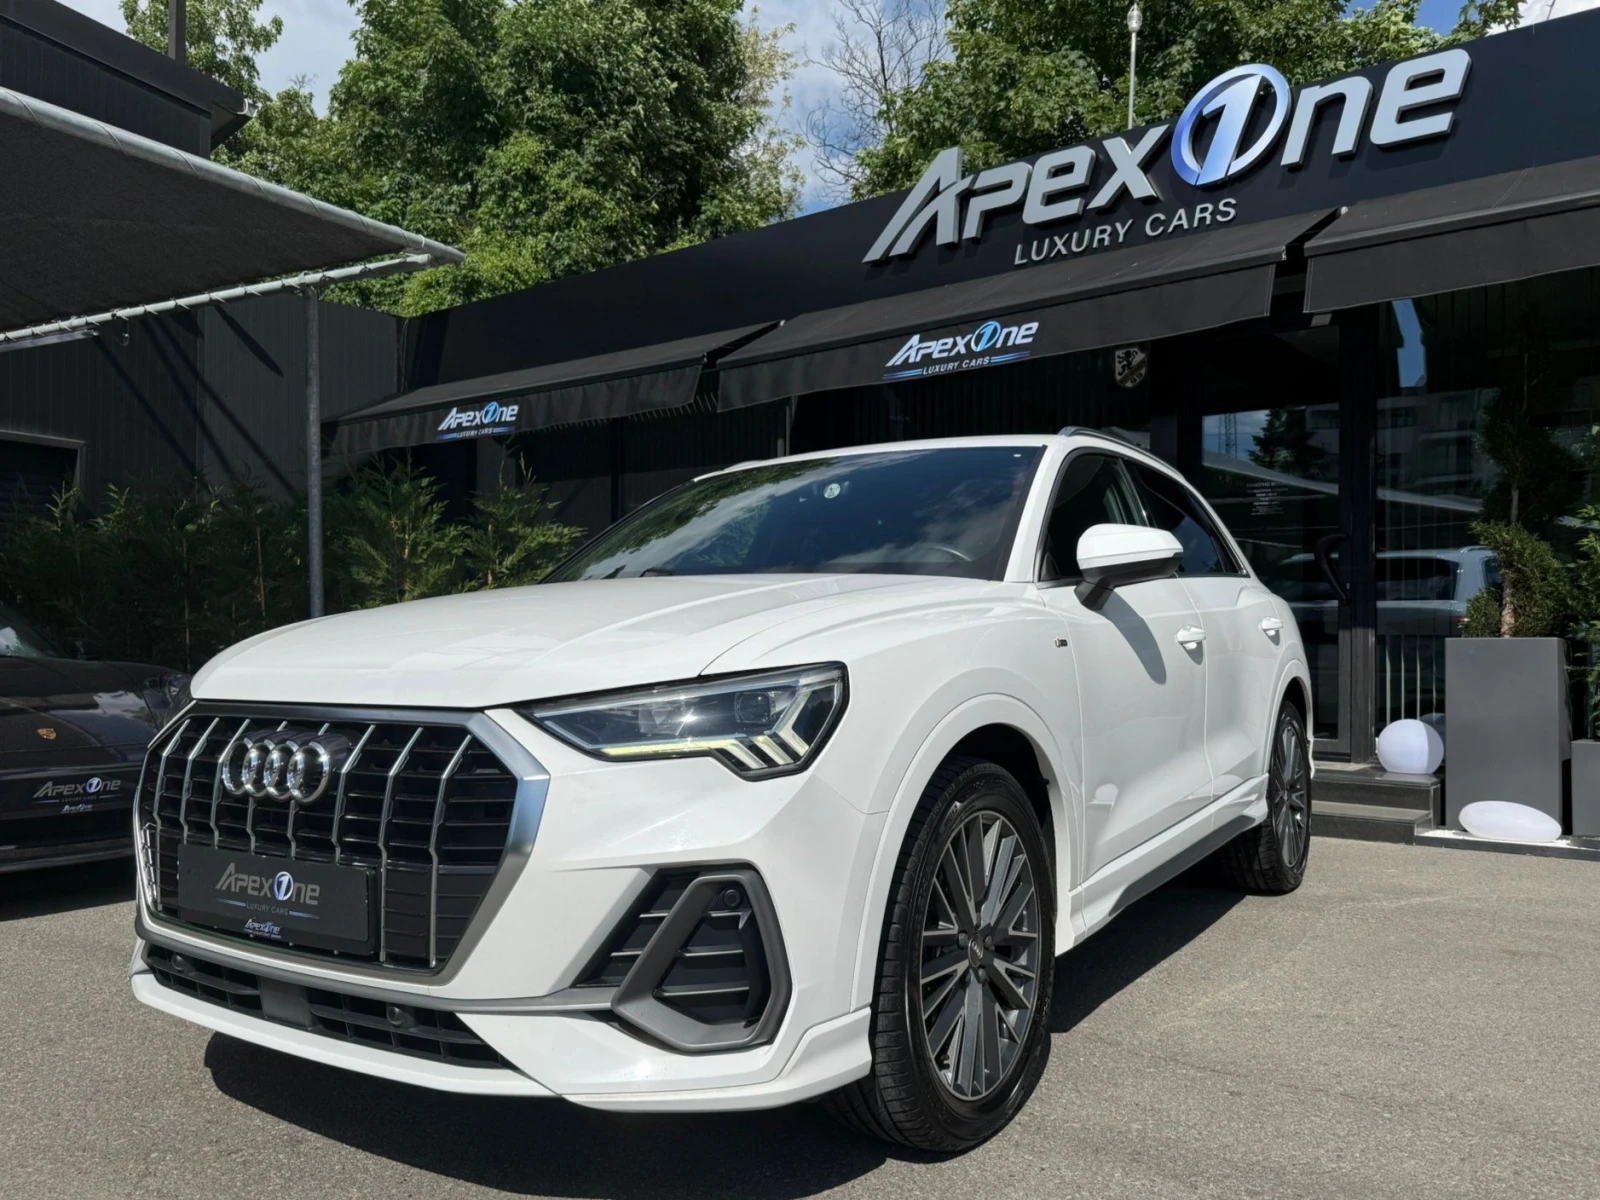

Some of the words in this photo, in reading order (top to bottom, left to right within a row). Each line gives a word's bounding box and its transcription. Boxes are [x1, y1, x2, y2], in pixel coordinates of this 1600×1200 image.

[1013, 218, 1133, 266] LUXURY
[1145, 198, 1238, 238] CARS
[922, 361, 960, 375] LUXURY
[962, 356, 990, 369] CARS
[246, 901, 270, 912] LUXURY
[271, 905, 289, 916] CARS
